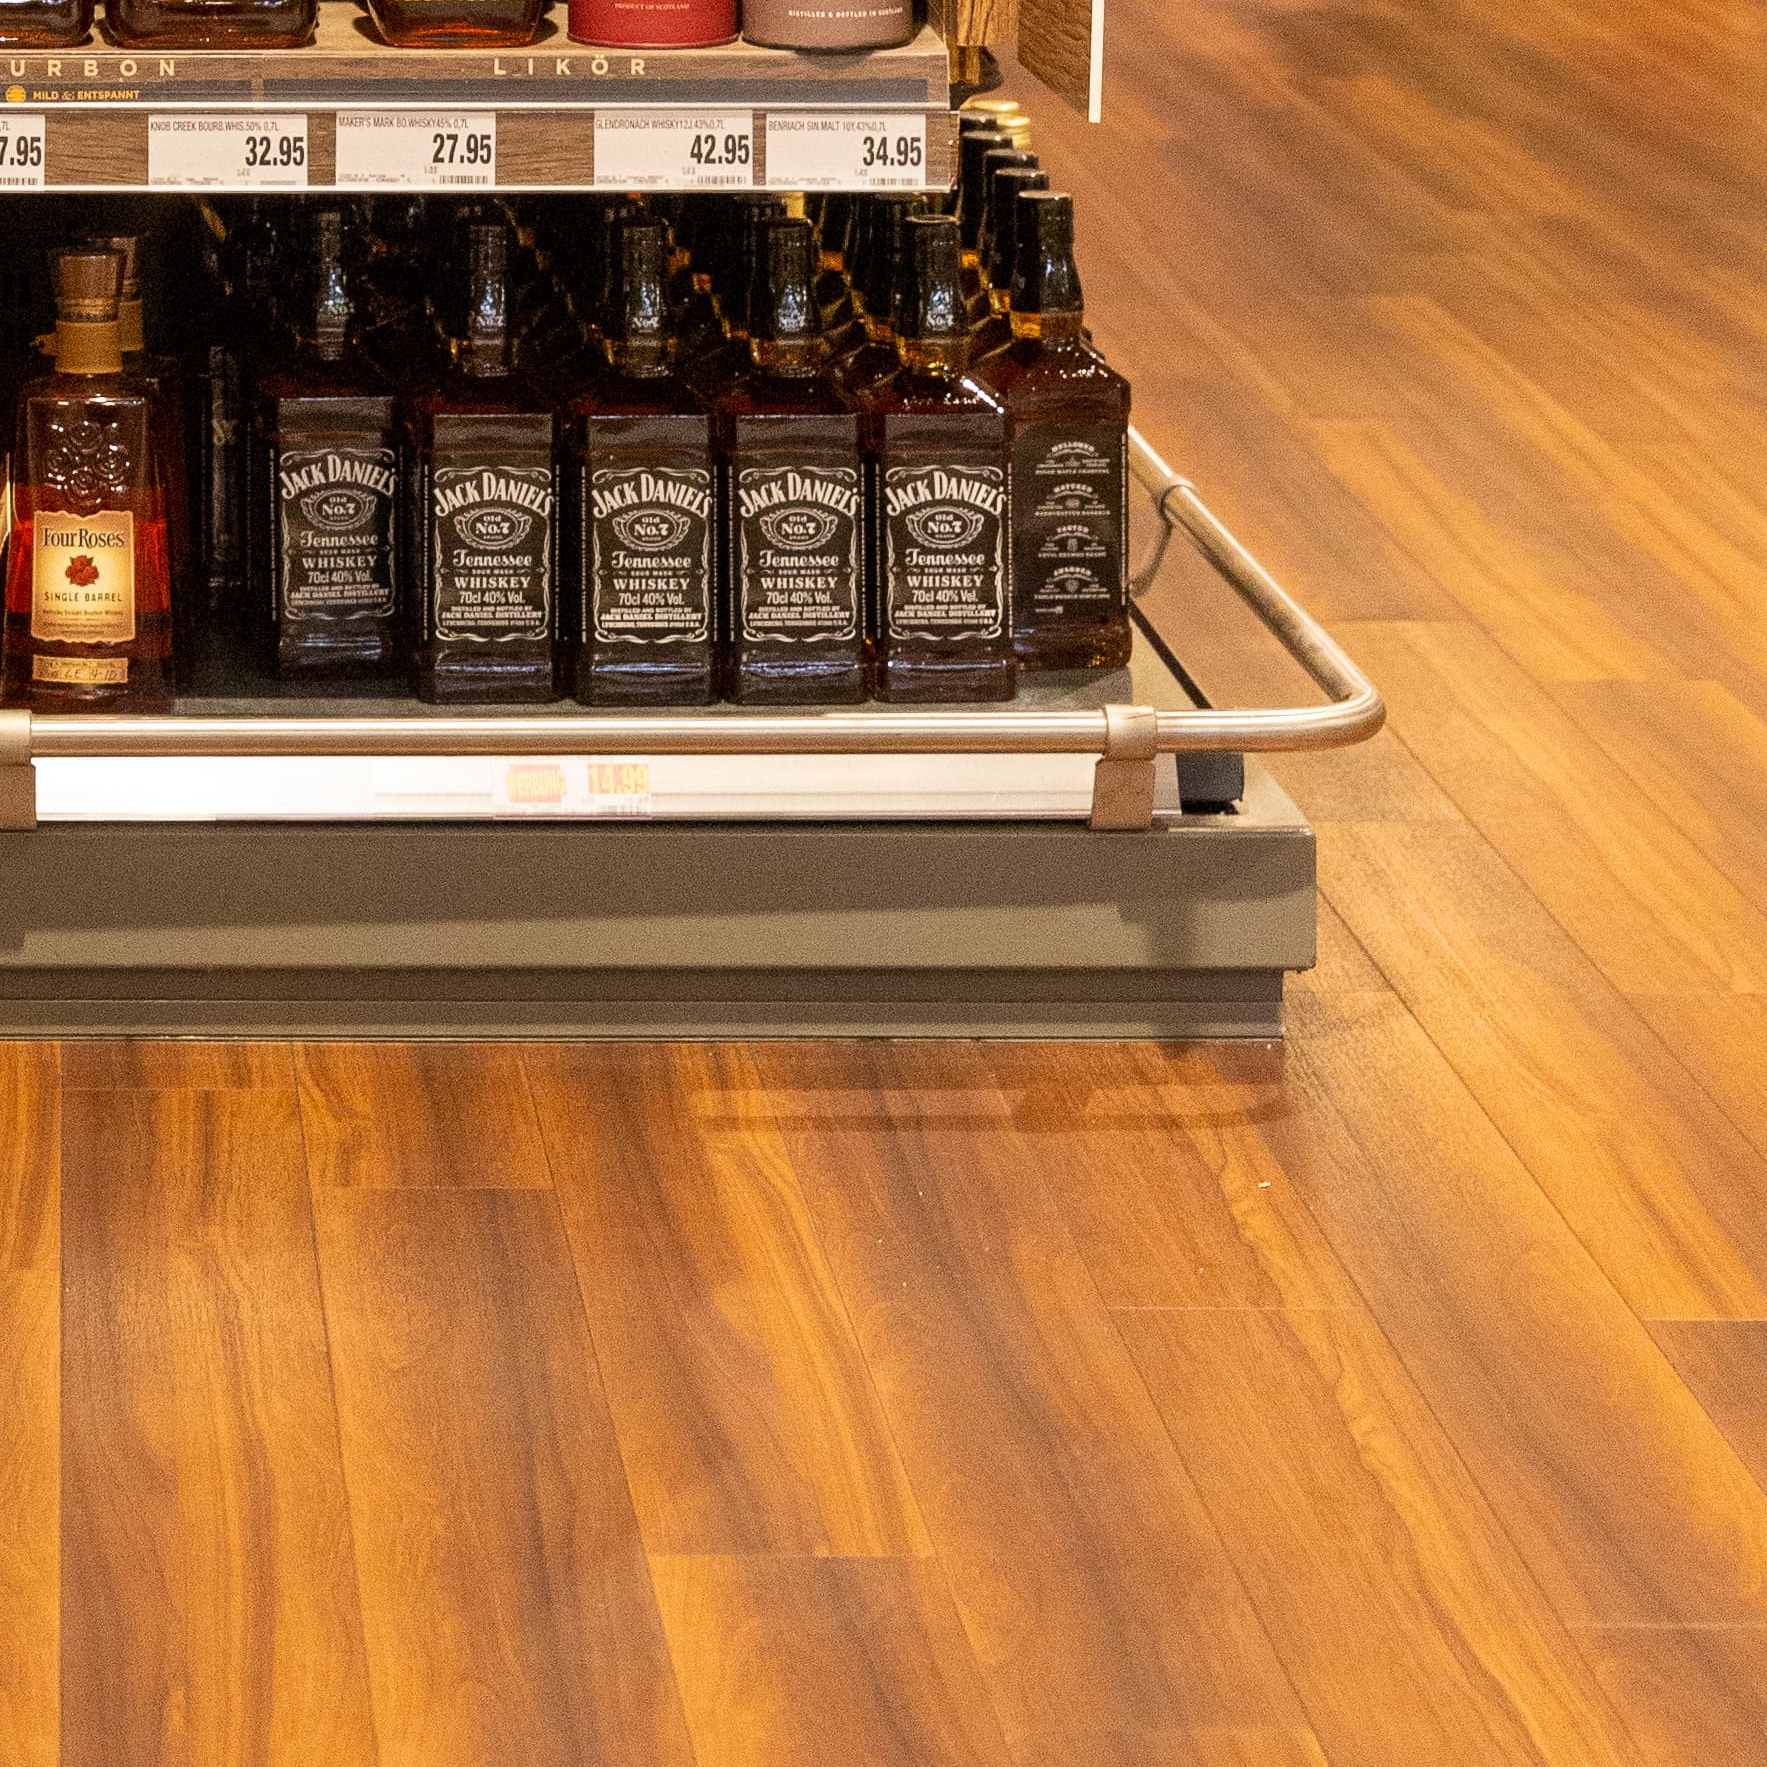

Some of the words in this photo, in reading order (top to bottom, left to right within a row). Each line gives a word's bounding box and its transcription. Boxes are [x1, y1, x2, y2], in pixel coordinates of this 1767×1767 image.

[493, 56, 646, 76] LIKÖR
[245, 137, 305, 165] 32.95
[433, 134, 492, 163] 27.95
[690, 134, 750, 164] 42.95
[863, 137, 922, 166] 34.95
[434, 482, 480, 517] JACK
[482, 474, 554, 515] DANIEL'S
[453, 549, 532, 567] Tennessee
[455, 576, 531, 589] WHISKEY
[588, 764, 650, 795] 14.99
